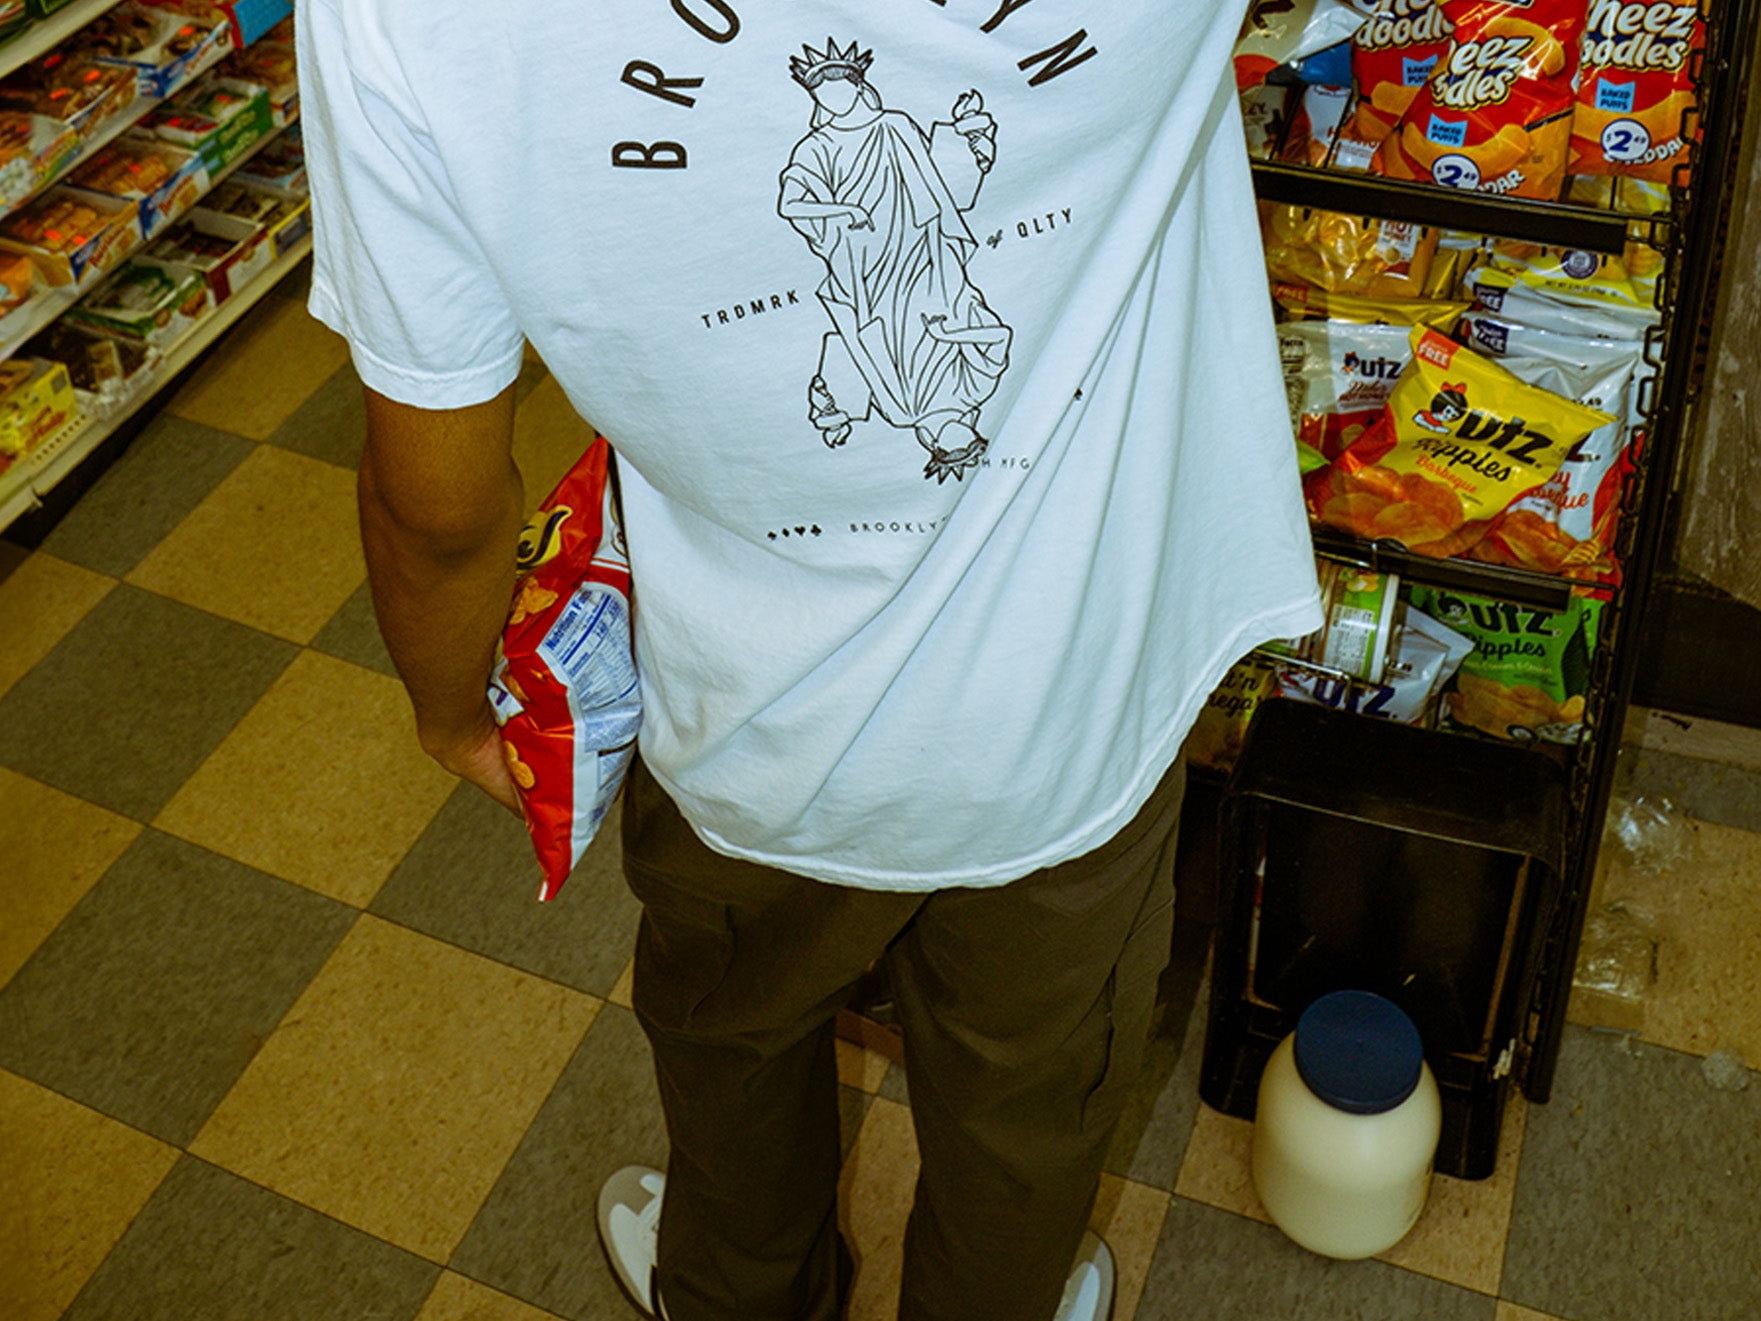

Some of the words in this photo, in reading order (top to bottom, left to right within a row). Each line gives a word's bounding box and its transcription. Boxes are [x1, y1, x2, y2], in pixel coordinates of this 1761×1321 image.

[1354, 3, 1456, 50] doodl
[1449, 36, 1524, 75] eez
[1581, 33, 1689, 71] oodles
[1431, 69, 1516, 108] dles
[1017, 208, 1074, 238] QLTY
[701, 289, 801, 330] TRDMRK
[1418, 341, 1450, 367] FREE
[1411, 437, 1513, 483] Ripples
[850, 516, 948, 533] BROOKLY
[1474, 636, 1547, 661] ipples
